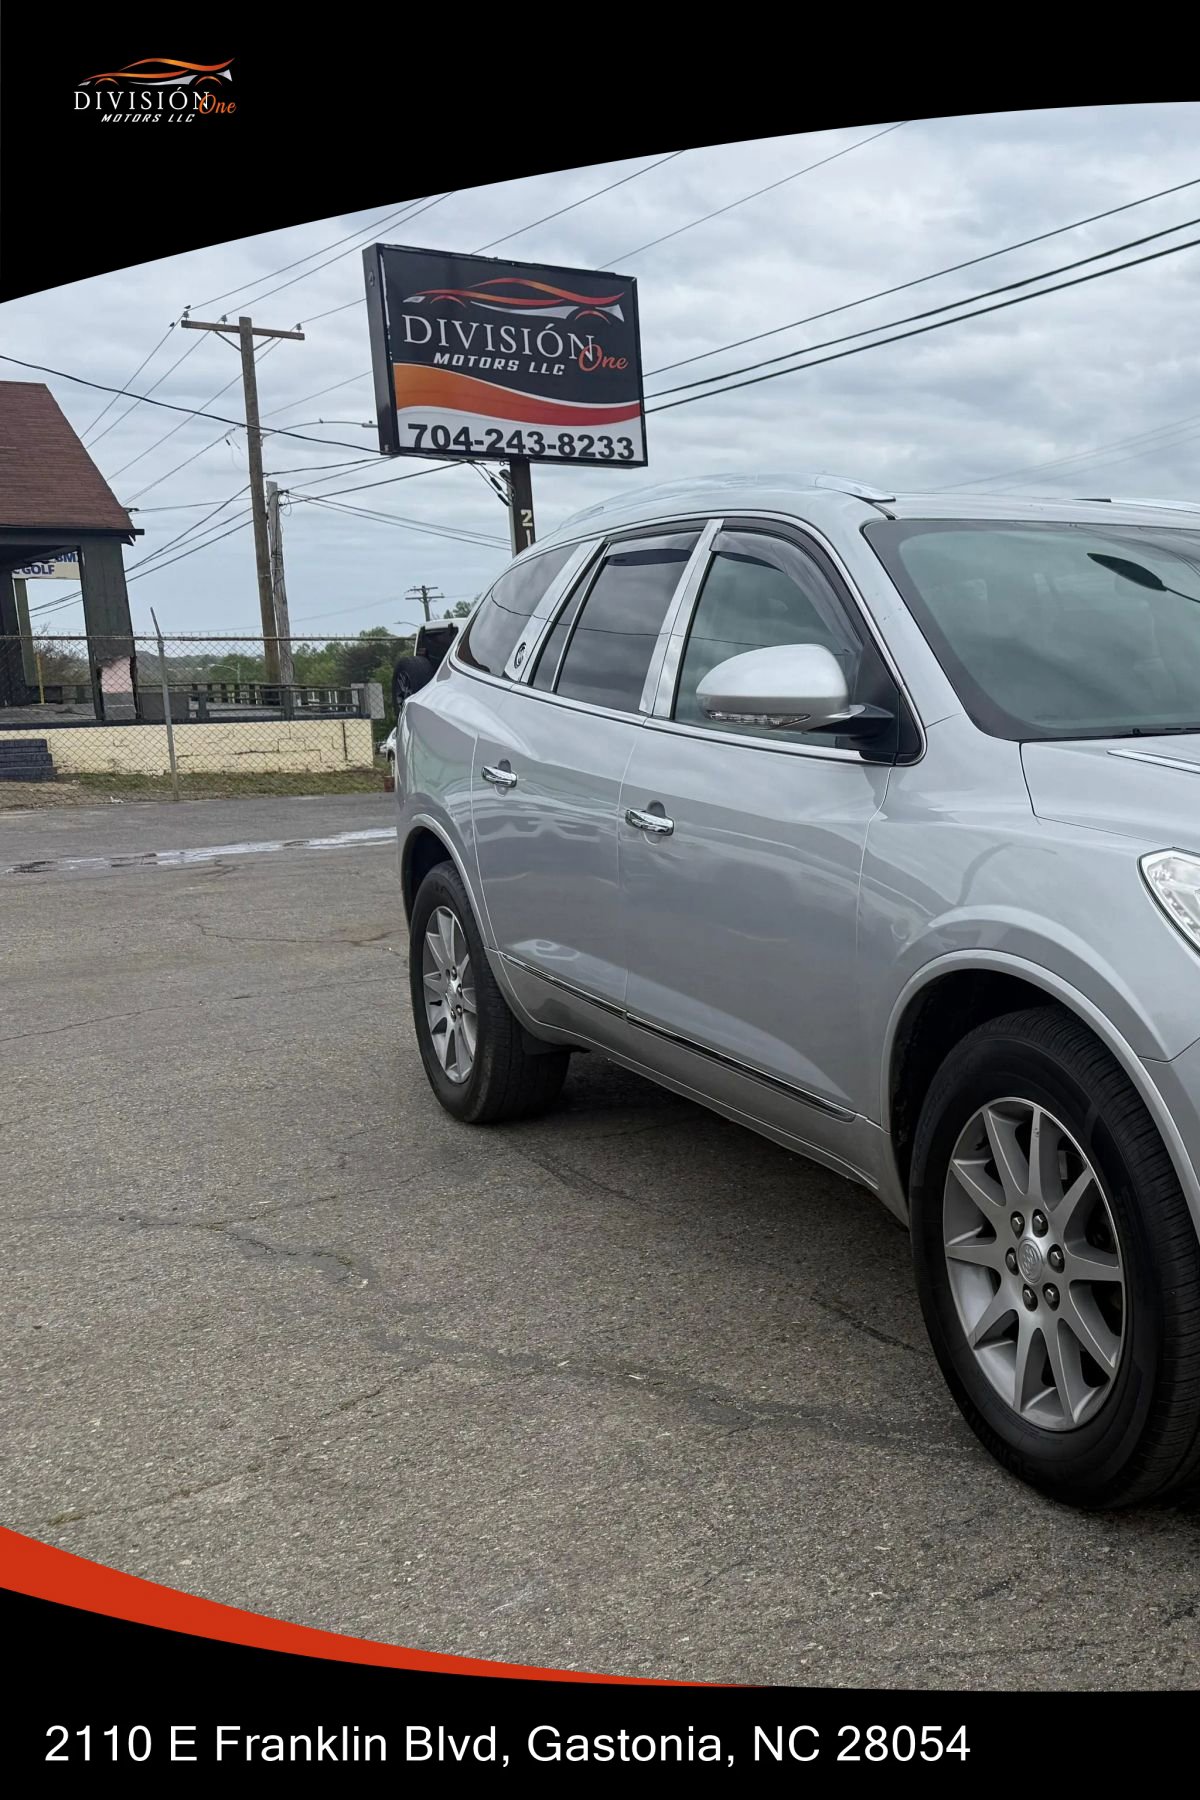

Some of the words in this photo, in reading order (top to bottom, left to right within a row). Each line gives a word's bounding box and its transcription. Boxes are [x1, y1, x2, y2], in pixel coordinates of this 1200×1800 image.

[401, 314, 595, 362] DIVISIÓN
[577, 343, 630, 372] One
[433, 352, 519, 372] MOTORS
[528, 361, 566, 376] LLC
[407, 423, 635, 460] 704-243-8233
[22, 564, 55, 575] GOLF
